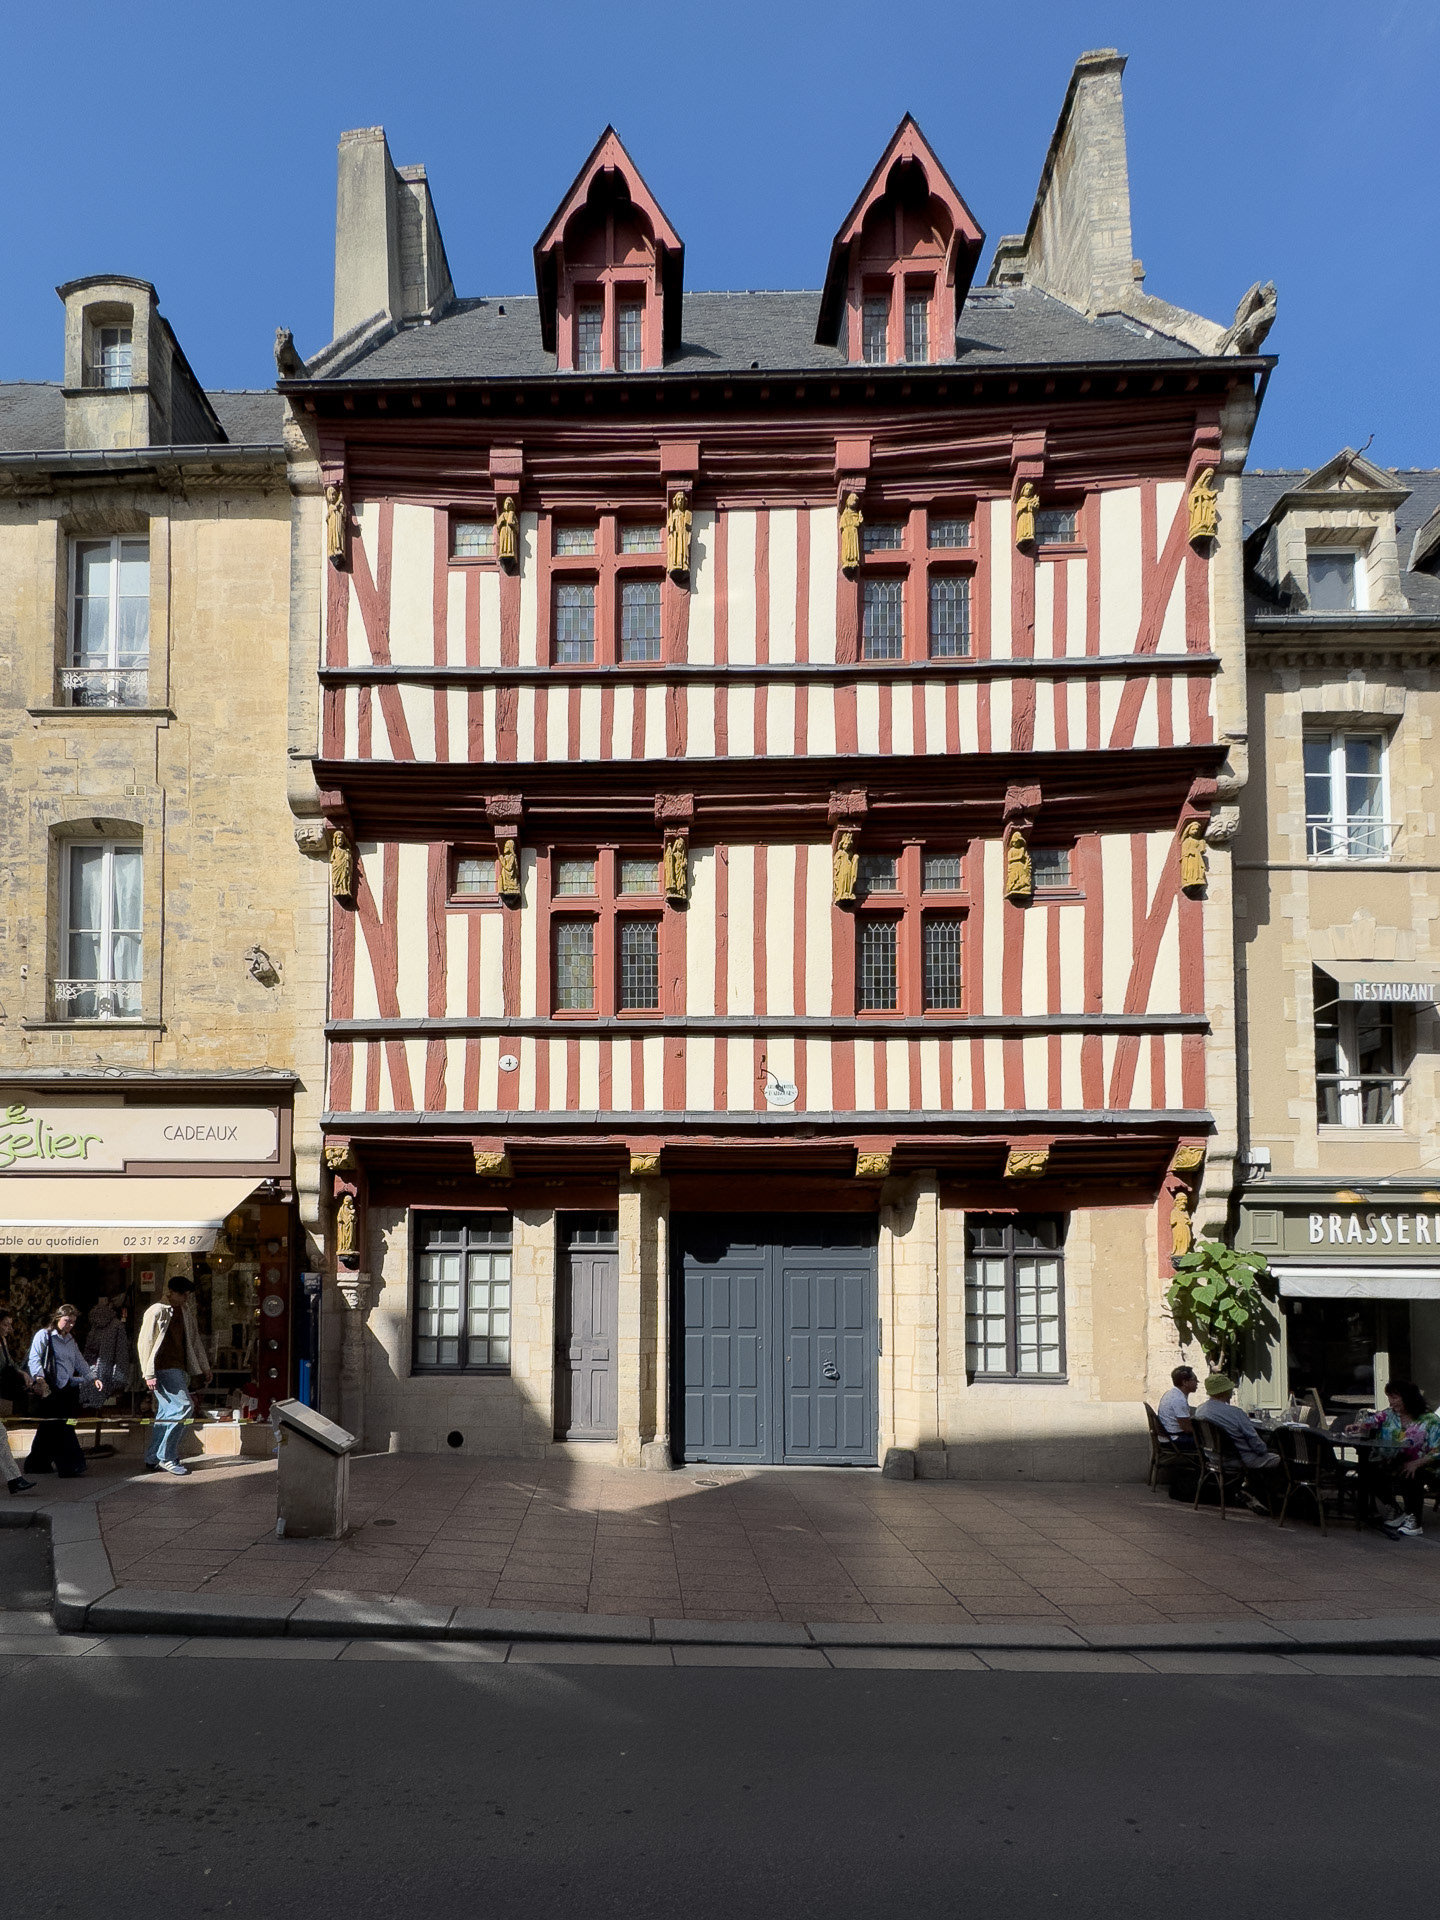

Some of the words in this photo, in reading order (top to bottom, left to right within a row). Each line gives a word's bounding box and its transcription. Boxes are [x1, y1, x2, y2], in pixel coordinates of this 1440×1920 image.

[1354, 983, 1436, 1001] RESTAURANT
[505, 1058, 512, 1067] 4
[163, 1125, 238, 1141] CADEAUX
[27, 1238, 42, 1246] au
[45, 1236, 99, 1248] quotidien
[123, 1236, 137, 1246] 02
[139, 1236, 152, 1246] 31
[157, 1236, 170, 1246] 92
[172, 1236, 186, 1245] 34
[189, 1235, 203, 1245] 87
